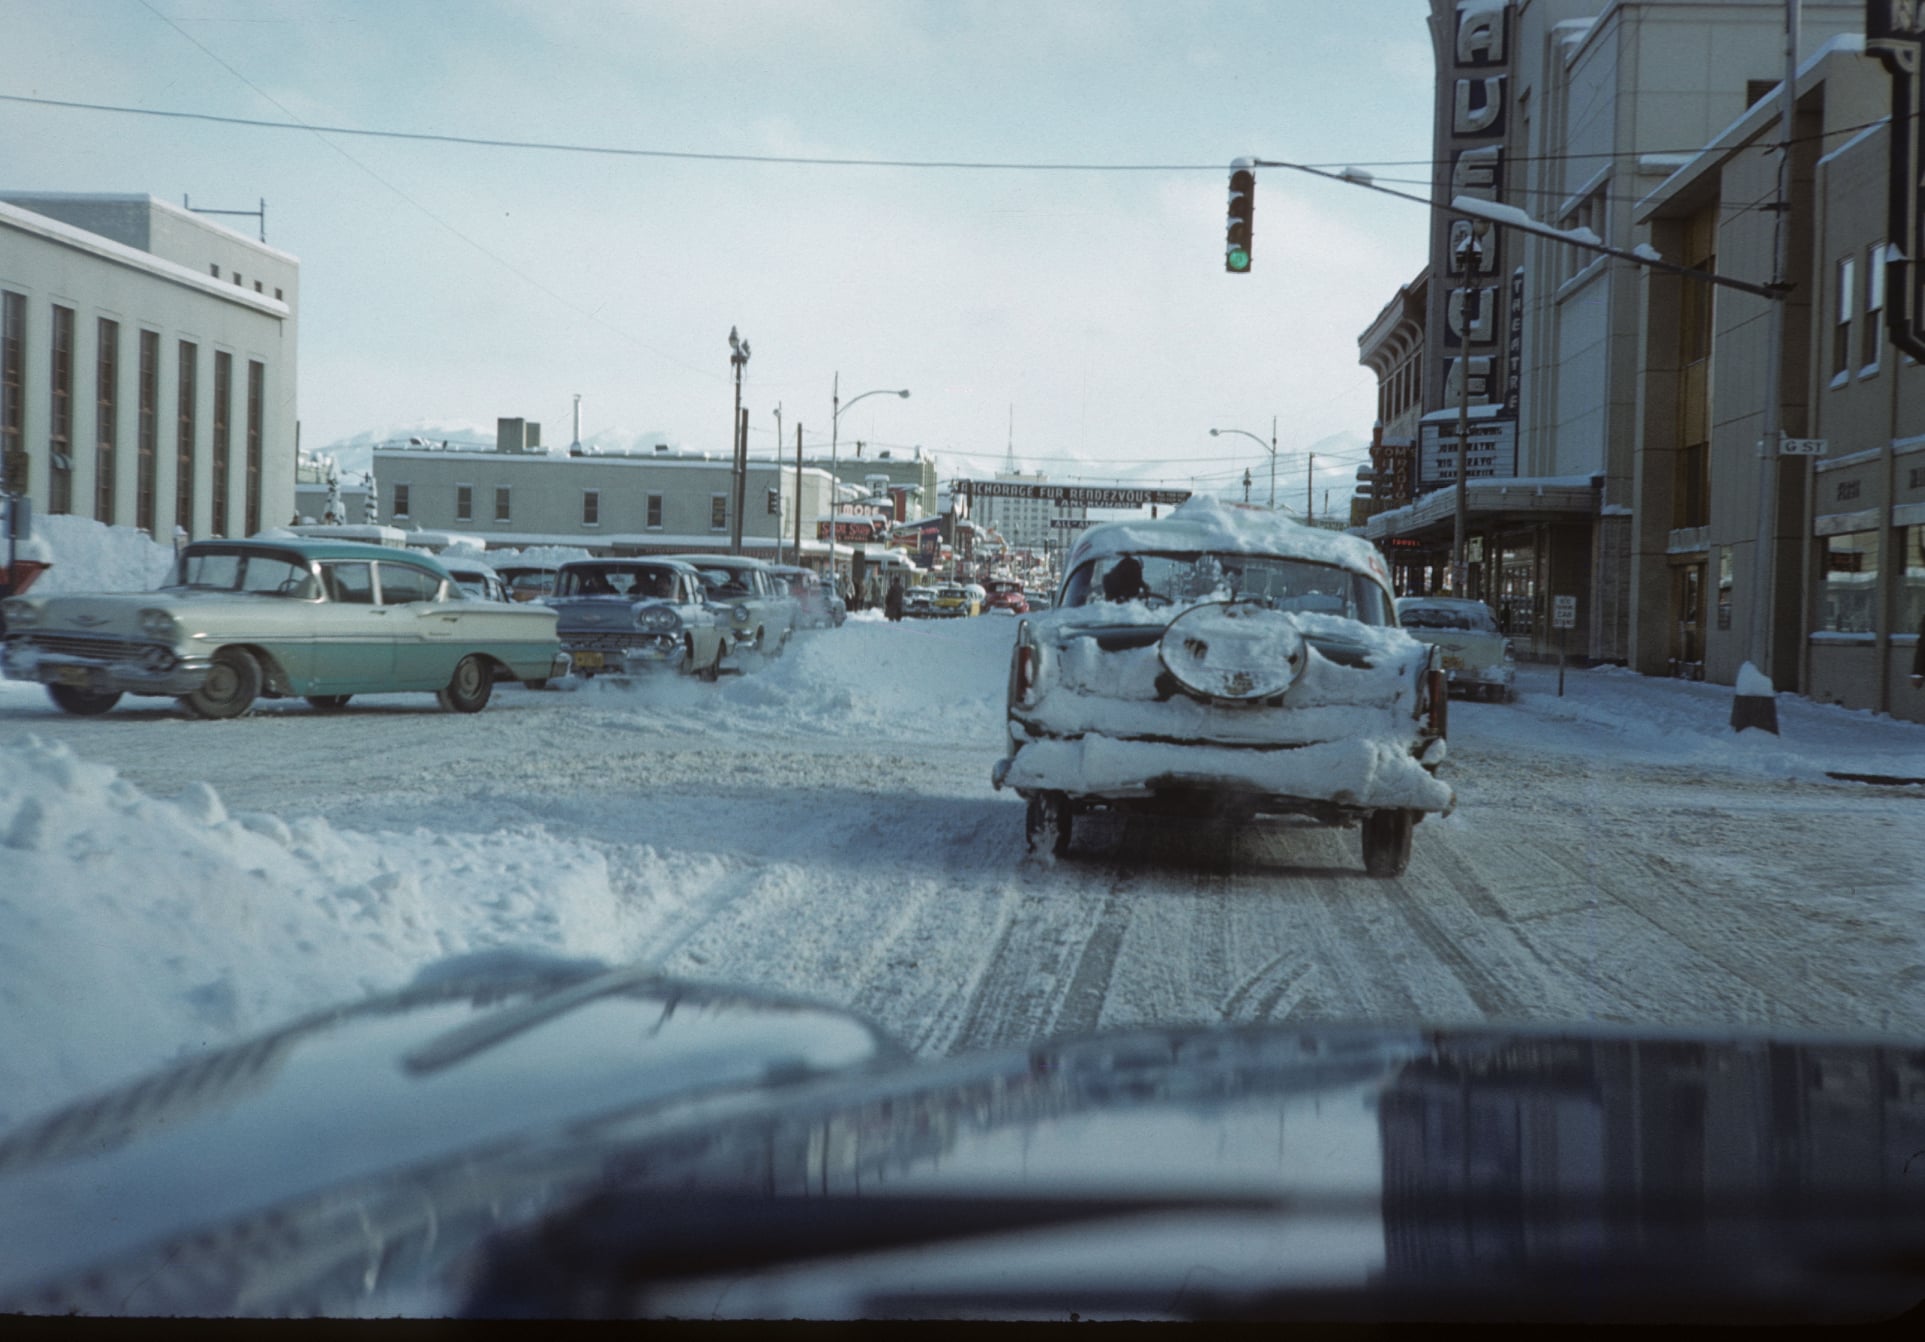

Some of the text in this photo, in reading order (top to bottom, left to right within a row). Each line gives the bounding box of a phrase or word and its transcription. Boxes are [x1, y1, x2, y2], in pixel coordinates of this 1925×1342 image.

[1509, 279, 1526, 409] THEATRE
[1785, 440, 1825, 453] G ST
[1039, 487, 1063, 500] FUR
[1069, 488, 1152, 503] RENDEZVOUS
